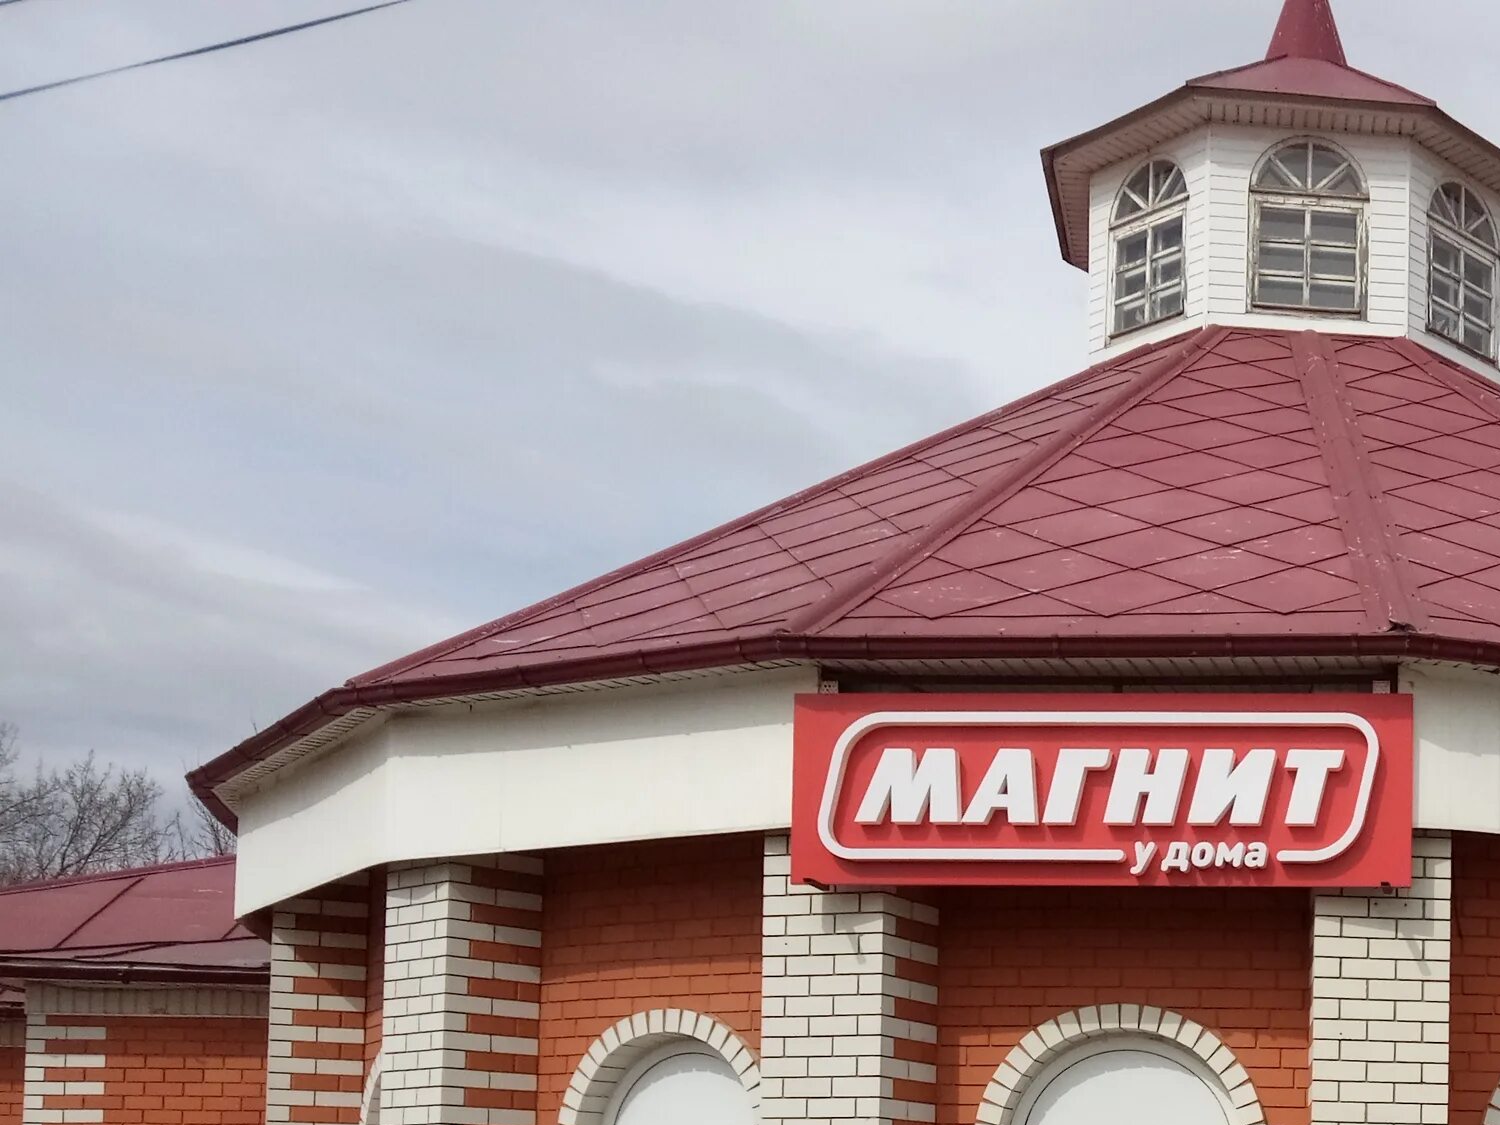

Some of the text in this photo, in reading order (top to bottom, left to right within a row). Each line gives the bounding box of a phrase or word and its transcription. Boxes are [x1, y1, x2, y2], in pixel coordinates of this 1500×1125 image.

[854, 747, 1346, 827] МАГНИТ
[1129, 841, 1269, 875] у дома
